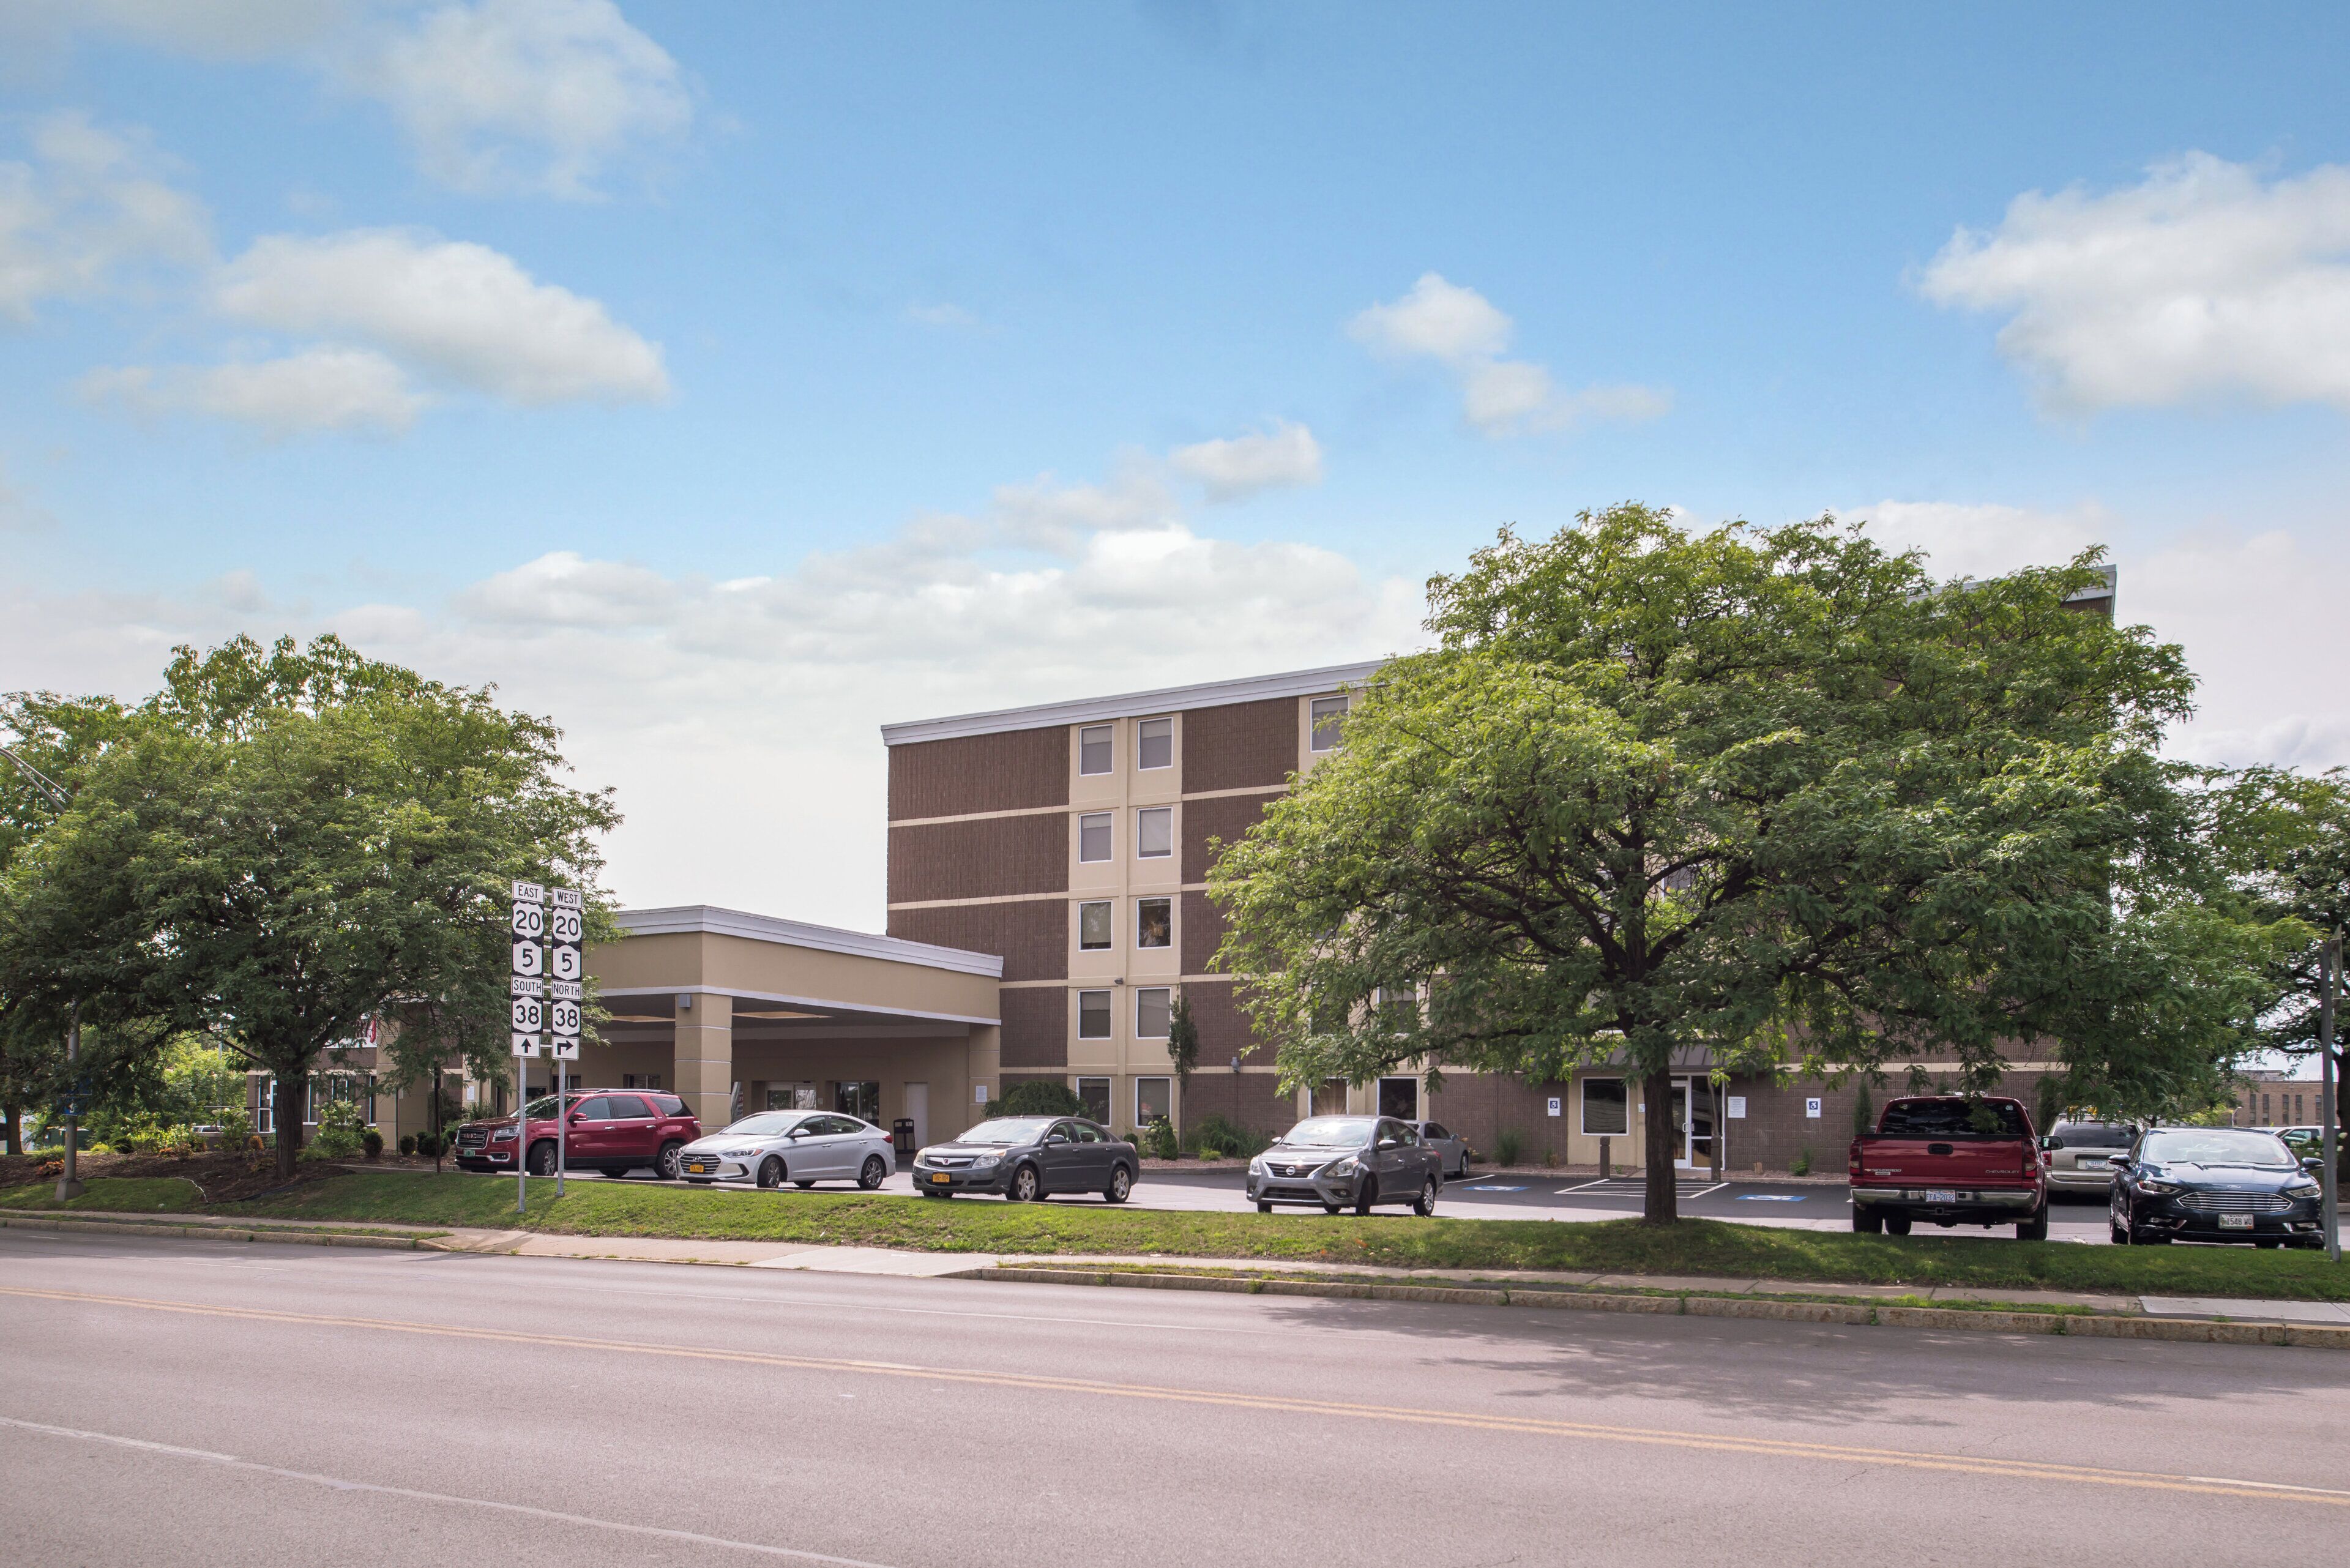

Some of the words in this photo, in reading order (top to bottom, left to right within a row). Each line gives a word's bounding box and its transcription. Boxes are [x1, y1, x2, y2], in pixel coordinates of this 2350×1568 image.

[518, 885, 539, 898] EAST
[557, 891, 578, 905] WEST
[515, 909, 540, 931] 20
[555, 916, 579, 936] 20
[522, 948, 534, 968] 5
[562, 952, 573, 972] 5
[513, 979, 542, 993] SOUTH
[553, 983, 580, 996] NORTH
[515, 1004, 539, 1025] 38
[554, 1008, 578, 1028] 38
